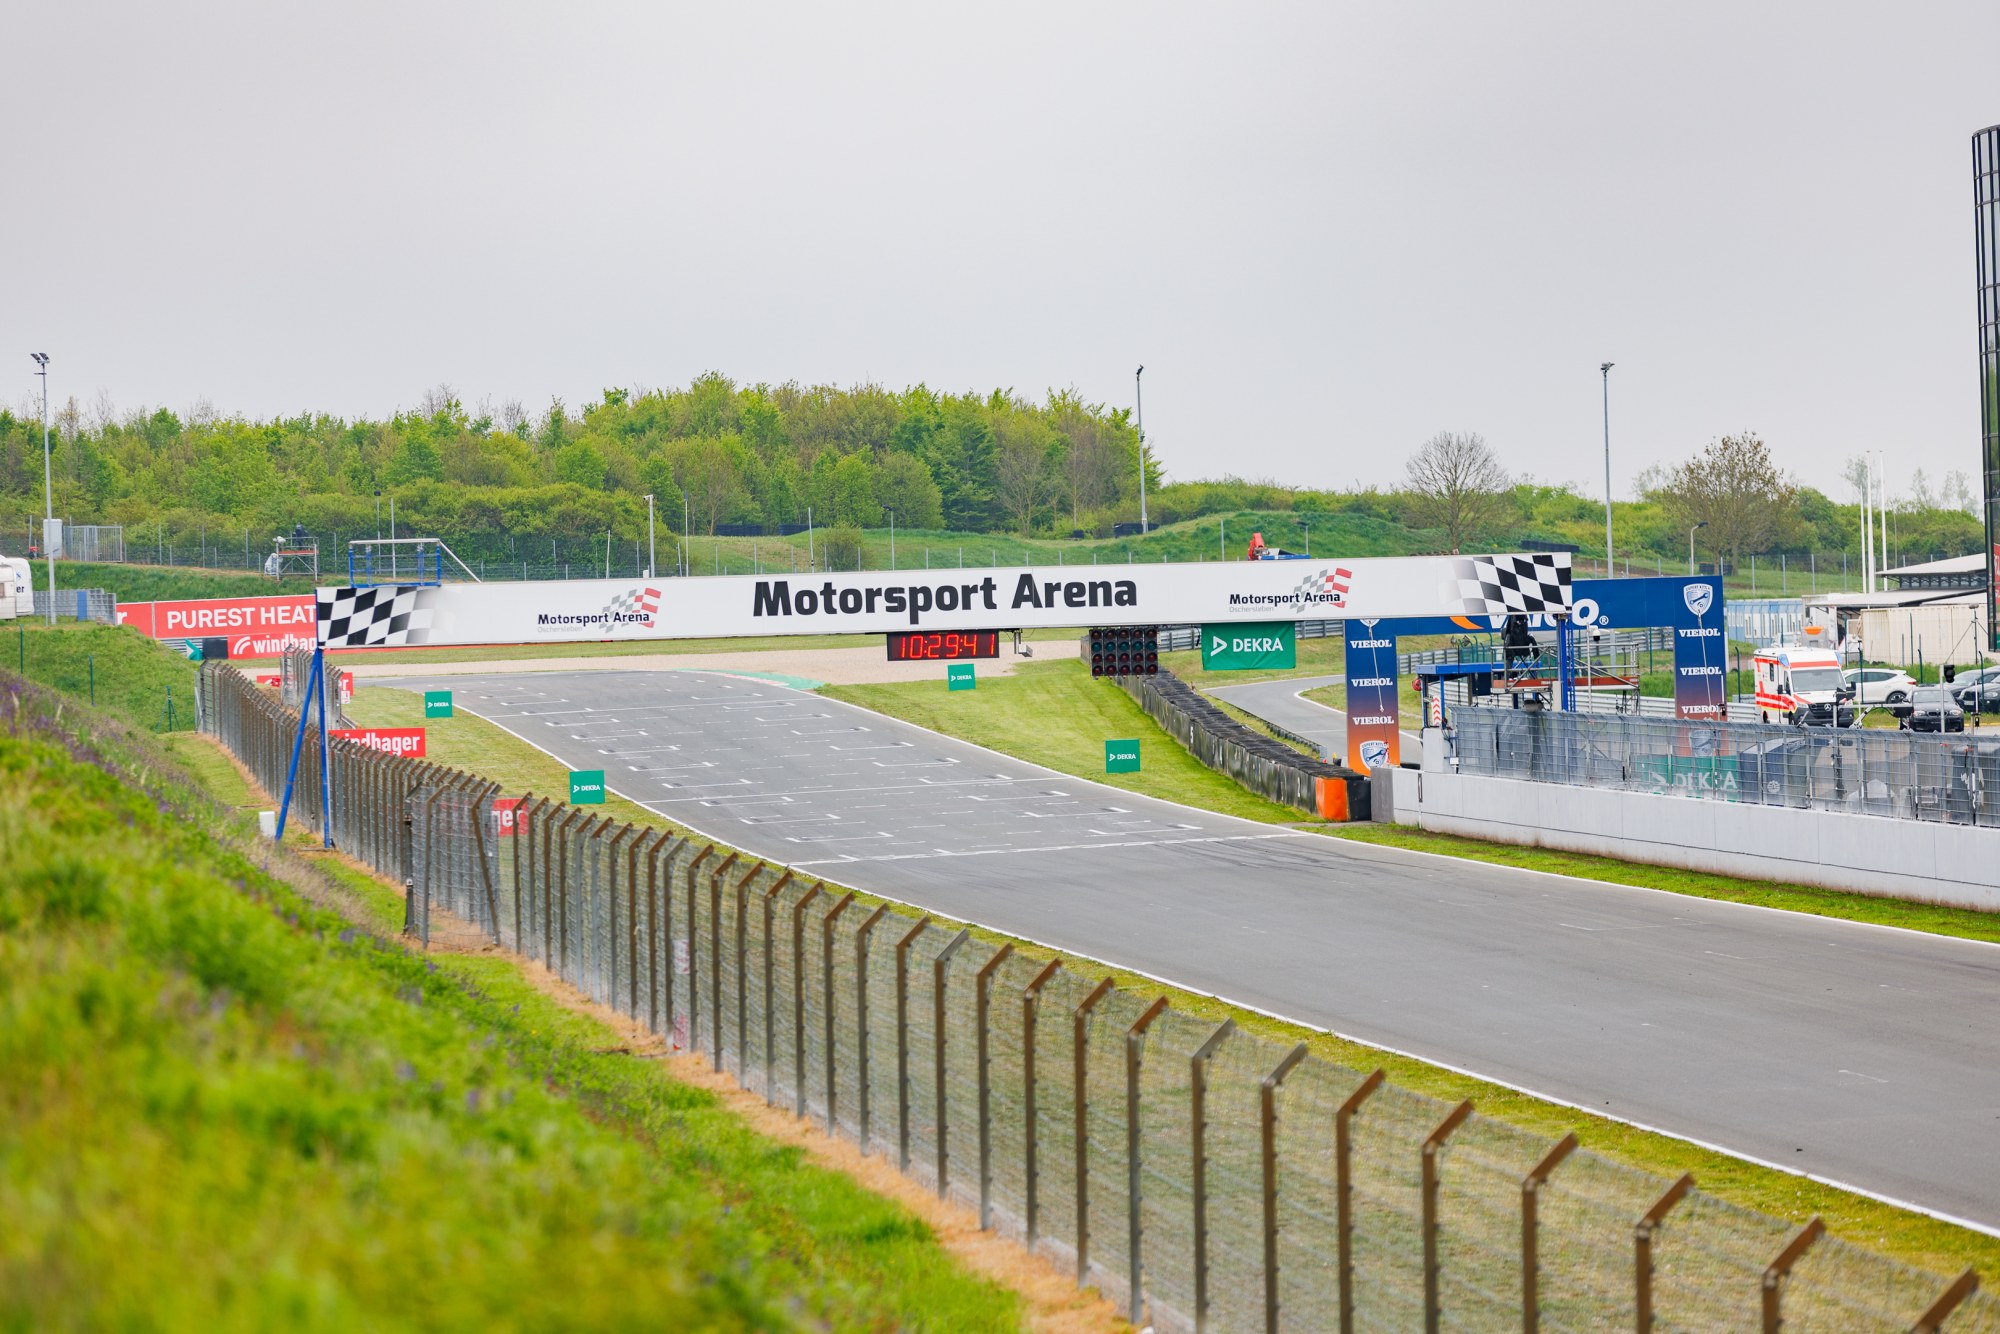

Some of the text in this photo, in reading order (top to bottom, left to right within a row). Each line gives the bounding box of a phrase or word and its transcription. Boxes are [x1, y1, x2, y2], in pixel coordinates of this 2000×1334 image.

[753, 573, 1137, 625] Motorsport Arena
[1229, 592, 1341, 607] Motorsport Arena
[1229, 605, 1274, 613] Oschersleben
[167, 604, 317, 629] PUREST HEAT
[538, 611, 650, 627] Motorsport Arena
[537, 625, 583, 633] Oschersleben
[1678, 628, 1721, 638] VIEROL
[901, 633, 995, 659] 10:29:41
[1232, 637, 1284, 653] DEKRA
[1350, 639, 1393, 649] VIEROL
[1679, 666, 1722, 676] VIEROL
[1351, 677, 1394, 688] VIEROL
[1681, 704, 1722, 715] VIEROL
[1352, 715, 1395, 726] VIEROL
[1116, 752, 1137, 761] DEKRA
[580, 784, 601, 792] DEKRA
